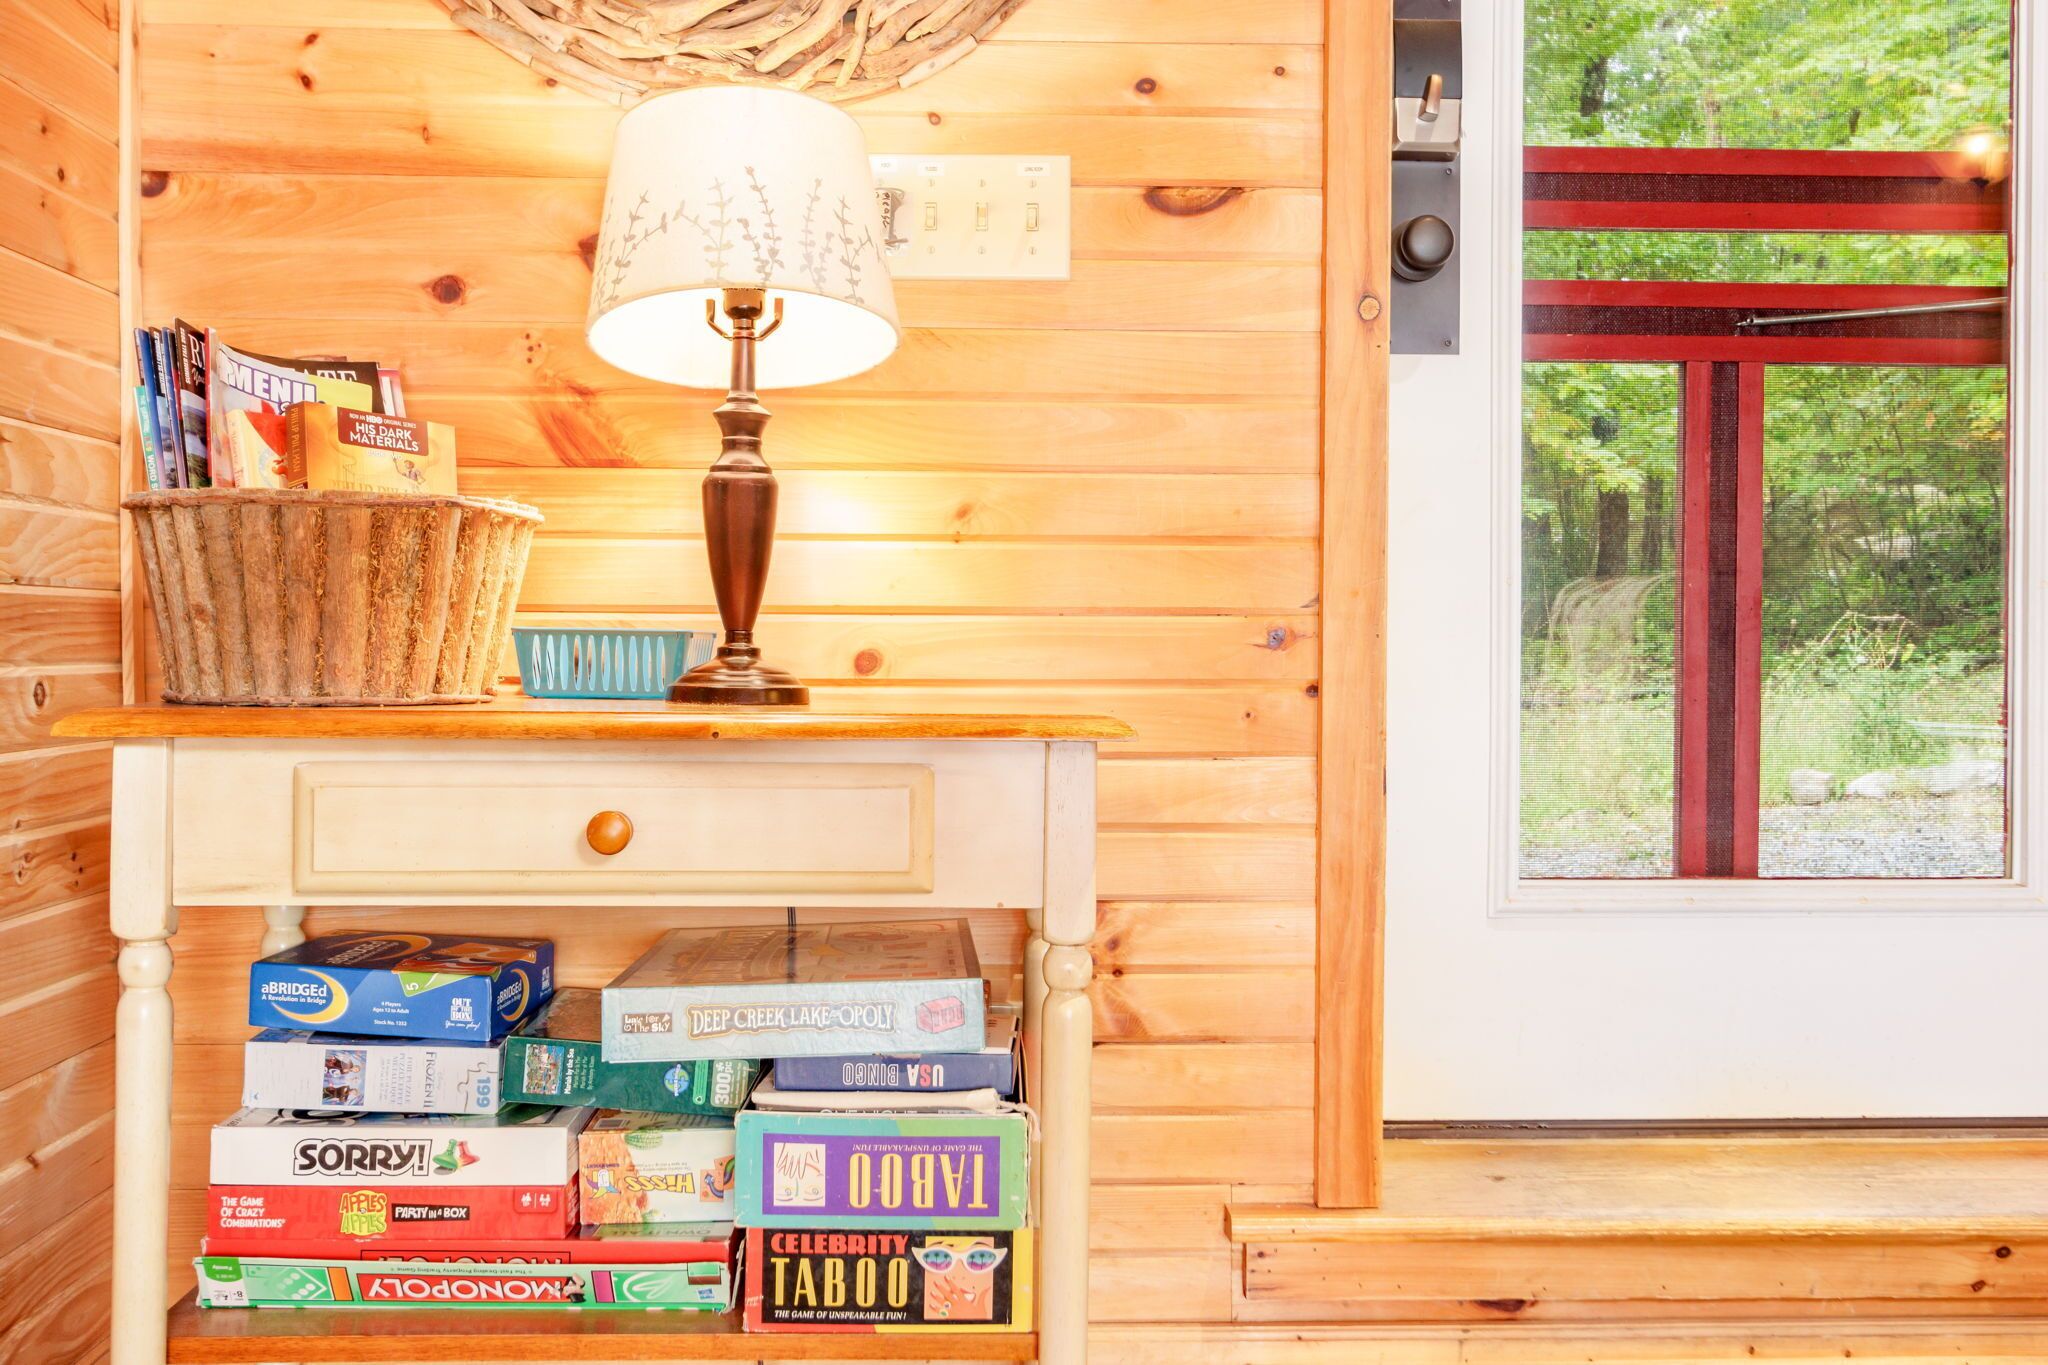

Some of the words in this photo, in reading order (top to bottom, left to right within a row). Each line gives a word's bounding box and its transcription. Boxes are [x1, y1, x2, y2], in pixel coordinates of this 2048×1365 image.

[366, 414, 383, 424] HBO
[384, 418, 402, 427] ORIGINAL
[356, 422, 376, 434] HIS
[379, 426, 412, 440] DARK
[350, 432, 419, 452] MATERIALS
[261, 982, 327, 996] aBRIDGEd
[268, 994, 298, 1002] Revolution
[307, 996, 326, 1005] Bridge
[452, 998, 472, 1006] OUT
[452, 1012, 472, 1020] BOX
[692, 1009, 732, 1035] DEEP
[734, 1006, 785, 1029] CREEK
[566, 1048, 574, 1058] Sea
[424, 1052, 437, 1098] FROZEN
[842, 1062, 898, 1086] BINGO
[906, 1064, 944, 1088] USA
[476, 1075, 492, 1109] 199
[714, 1072, 730, 1104] 300
[423, 1100, 434, 1108] II
[298, 1144, 426, 1171] SORRY!
[874, 1144, 930, 1152] UNSPEAKABLE
[932, 1144, 941, 1152] OF
[943, 1144, 966, 1152] GAME
[968, 1144, 983, 1152] THE
[849, 1153, 988, 1208] TABOO
[340, 1192, 388, 1214] APPLES
[395, 1206, 428, 1219] PARTY
[444, 1207, 467, 1218] BOX
[342, 1212, 387, 1234] APPLES
[770, 1233, 910, 1255] CELEBRITY
[368, 1276, 562, 1300] MONOPOLY
[770, 1258, 910, 1308] TABOO
[774, 1310, 790, 1318] THE
[792, 1310, 814, 1318] GAME
[816, 1311, 828, 1319] OF
[828, 1311, 884, 1320] UNSPEAKABLE
[886, 1312, 907, 1320] FUN!
